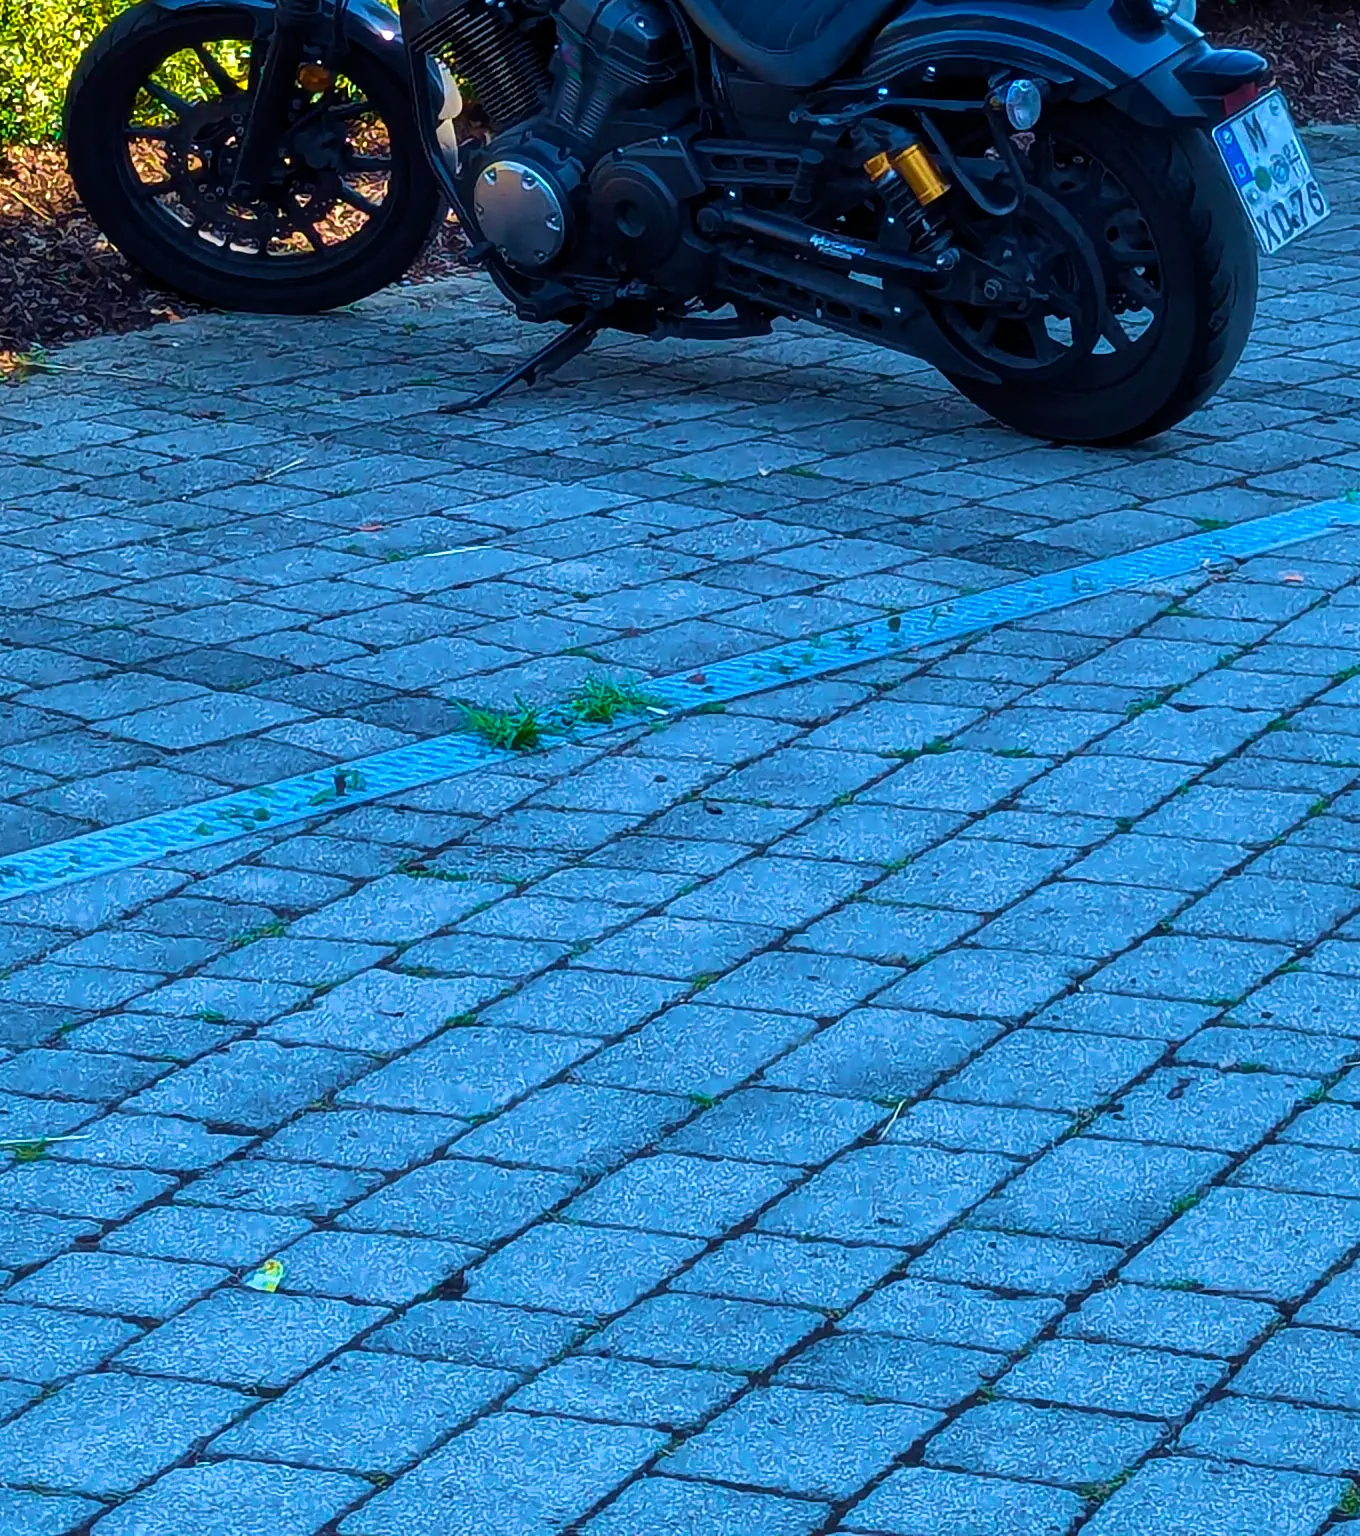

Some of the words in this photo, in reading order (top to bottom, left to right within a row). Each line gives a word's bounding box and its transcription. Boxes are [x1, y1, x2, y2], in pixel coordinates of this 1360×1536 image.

[1242, 113, 1268, 153] M
[1234, 162, 1247, 179] D
[1292, 181, 1325, 229] 76
